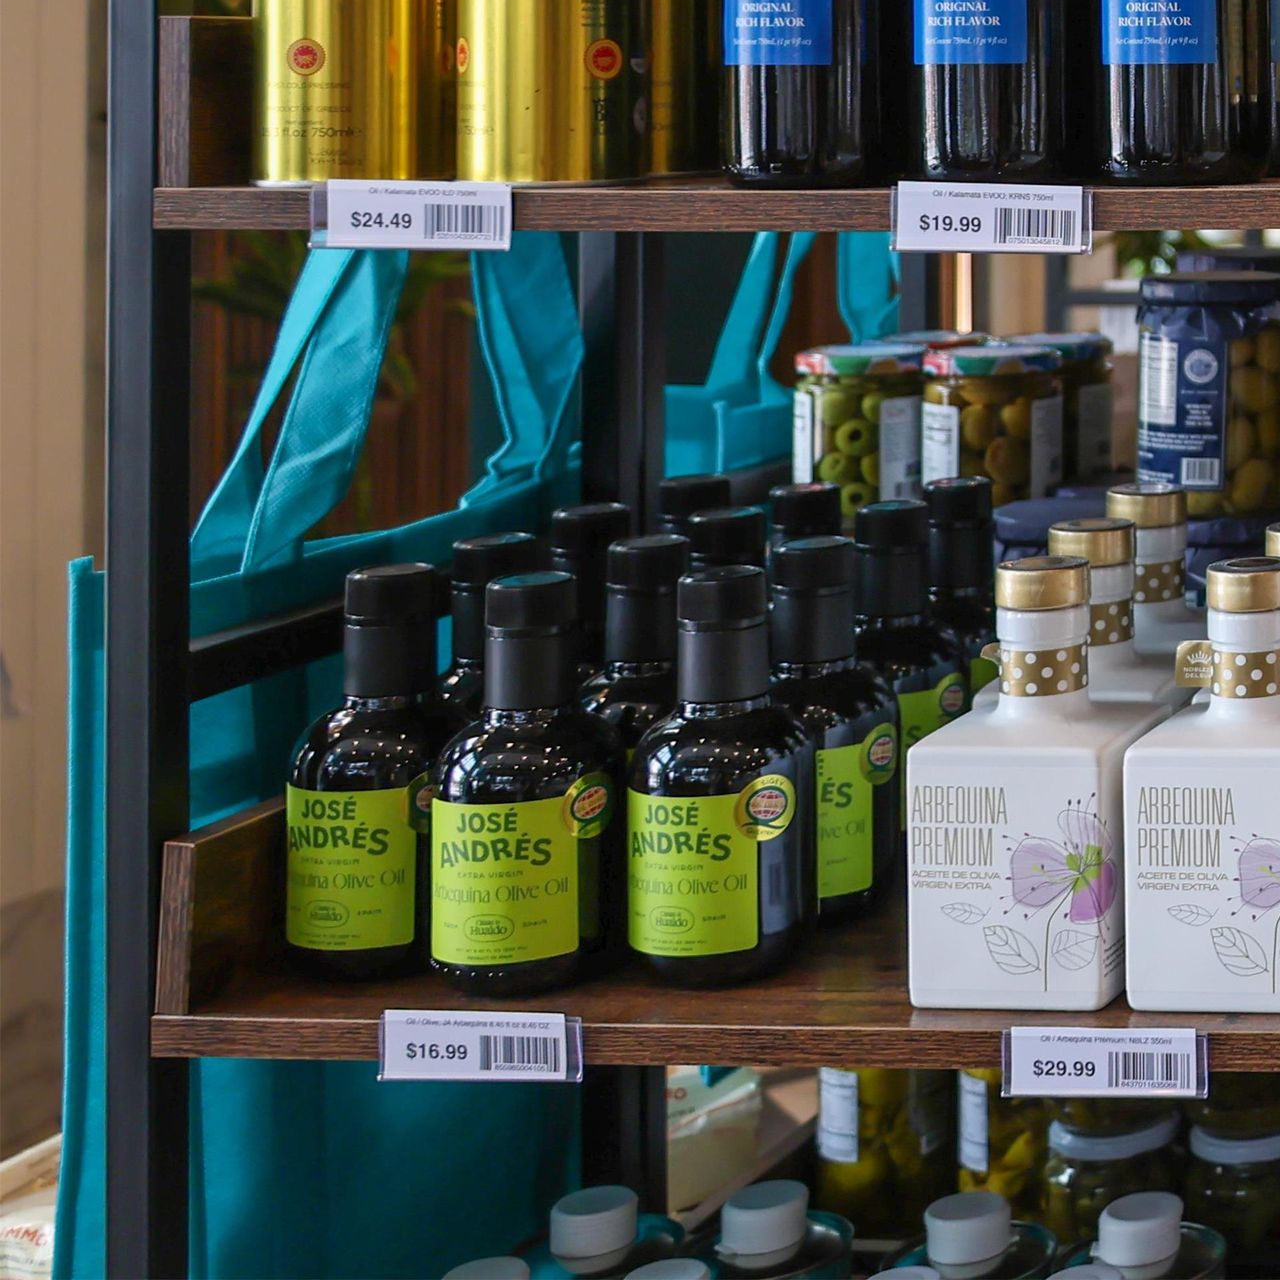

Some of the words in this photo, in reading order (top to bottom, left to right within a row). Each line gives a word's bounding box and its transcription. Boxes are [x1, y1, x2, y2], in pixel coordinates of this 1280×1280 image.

[935, 2, 990, 13] ORIGINAL
[928, 16, 955, 27] RICH
[956, 16, 1000, 27] FLAVOR
[350, 211, 412, 230] $24.49
[919, 214, 981, 232] $19.99
[912, 785, 1007, 824] ARBEQUINA
[456, 807, 518, 834] JOSÉ
[440, 834, 551, 869] ANDRÉS
[912, 827, 993, 866] PREMIUM
[912, 870, 948, 880] ACEITE
[952, 871, 967, 880] DE
[970, 871, 1001, 880] OLIVA
[912, 881, 955, 890] VIRGEN
[958, 881, 992, 890] EXTRA
[406, 1042, 467, 1060] $16.99
[1033, 1059, 1095, 1078] $29.99
